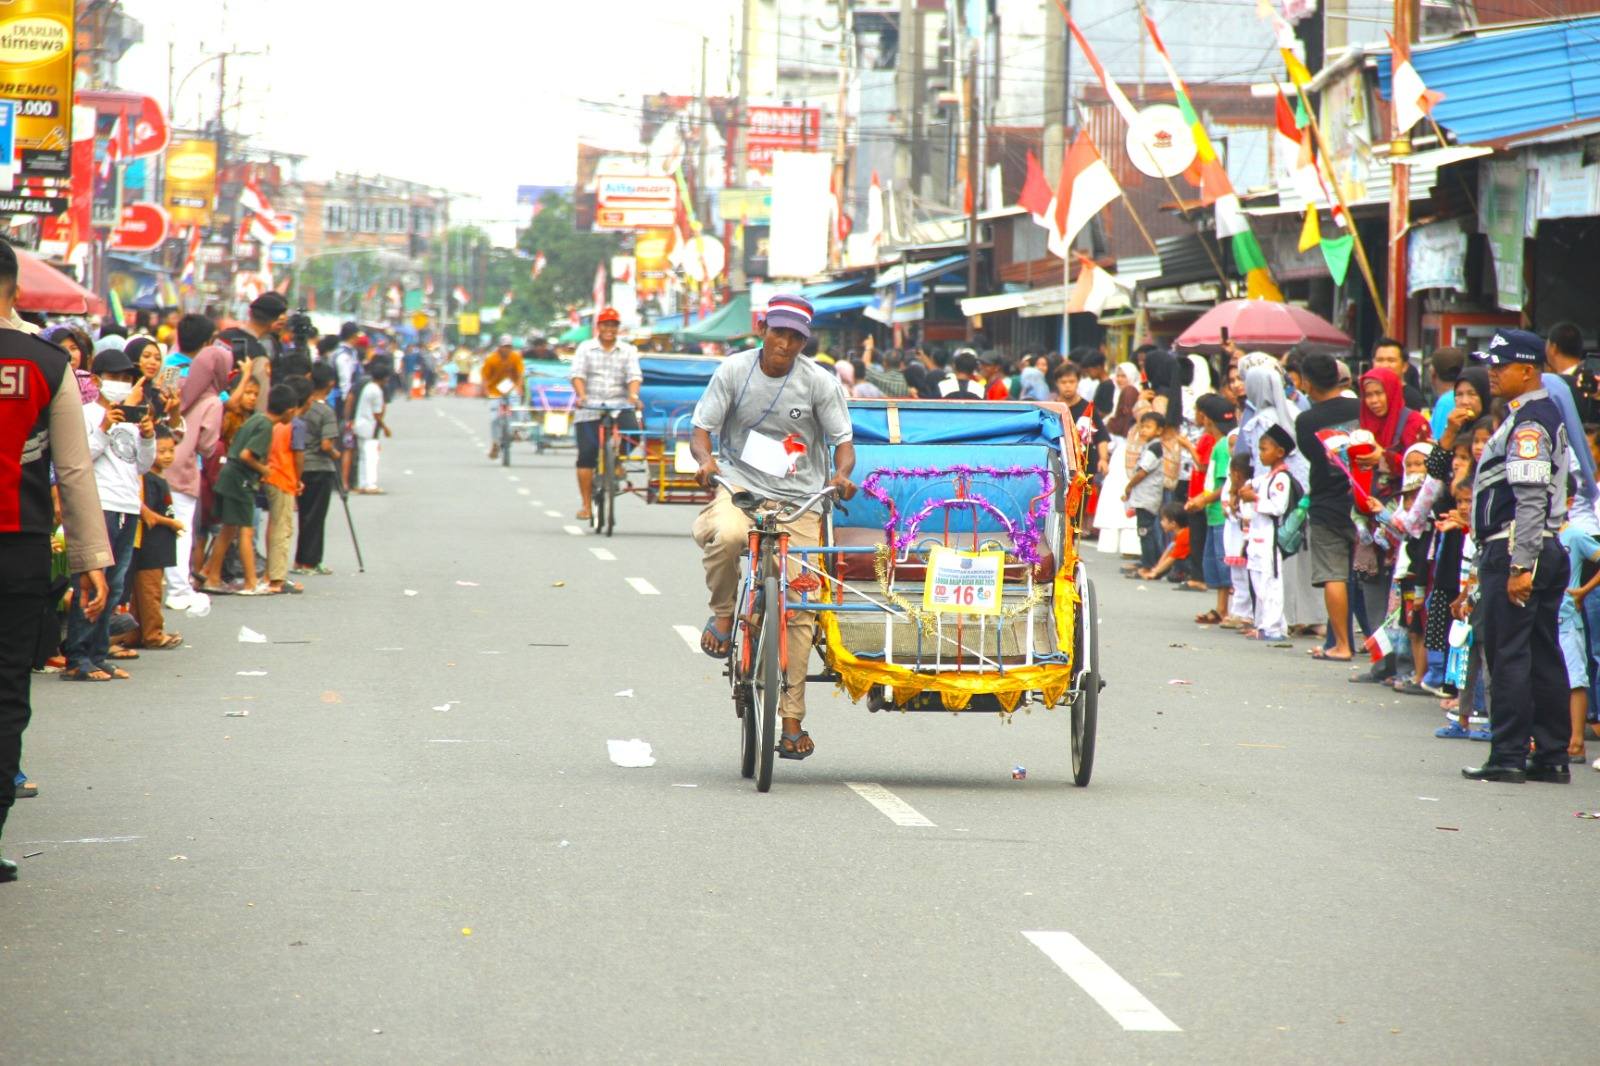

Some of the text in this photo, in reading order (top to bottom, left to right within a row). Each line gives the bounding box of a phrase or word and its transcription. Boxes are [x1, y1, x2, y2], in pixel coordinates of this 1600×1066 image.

[24, 200, 54, 213] CELL
[0, 366, 25, 395] SI
[953, 585, 974, 605] 16
